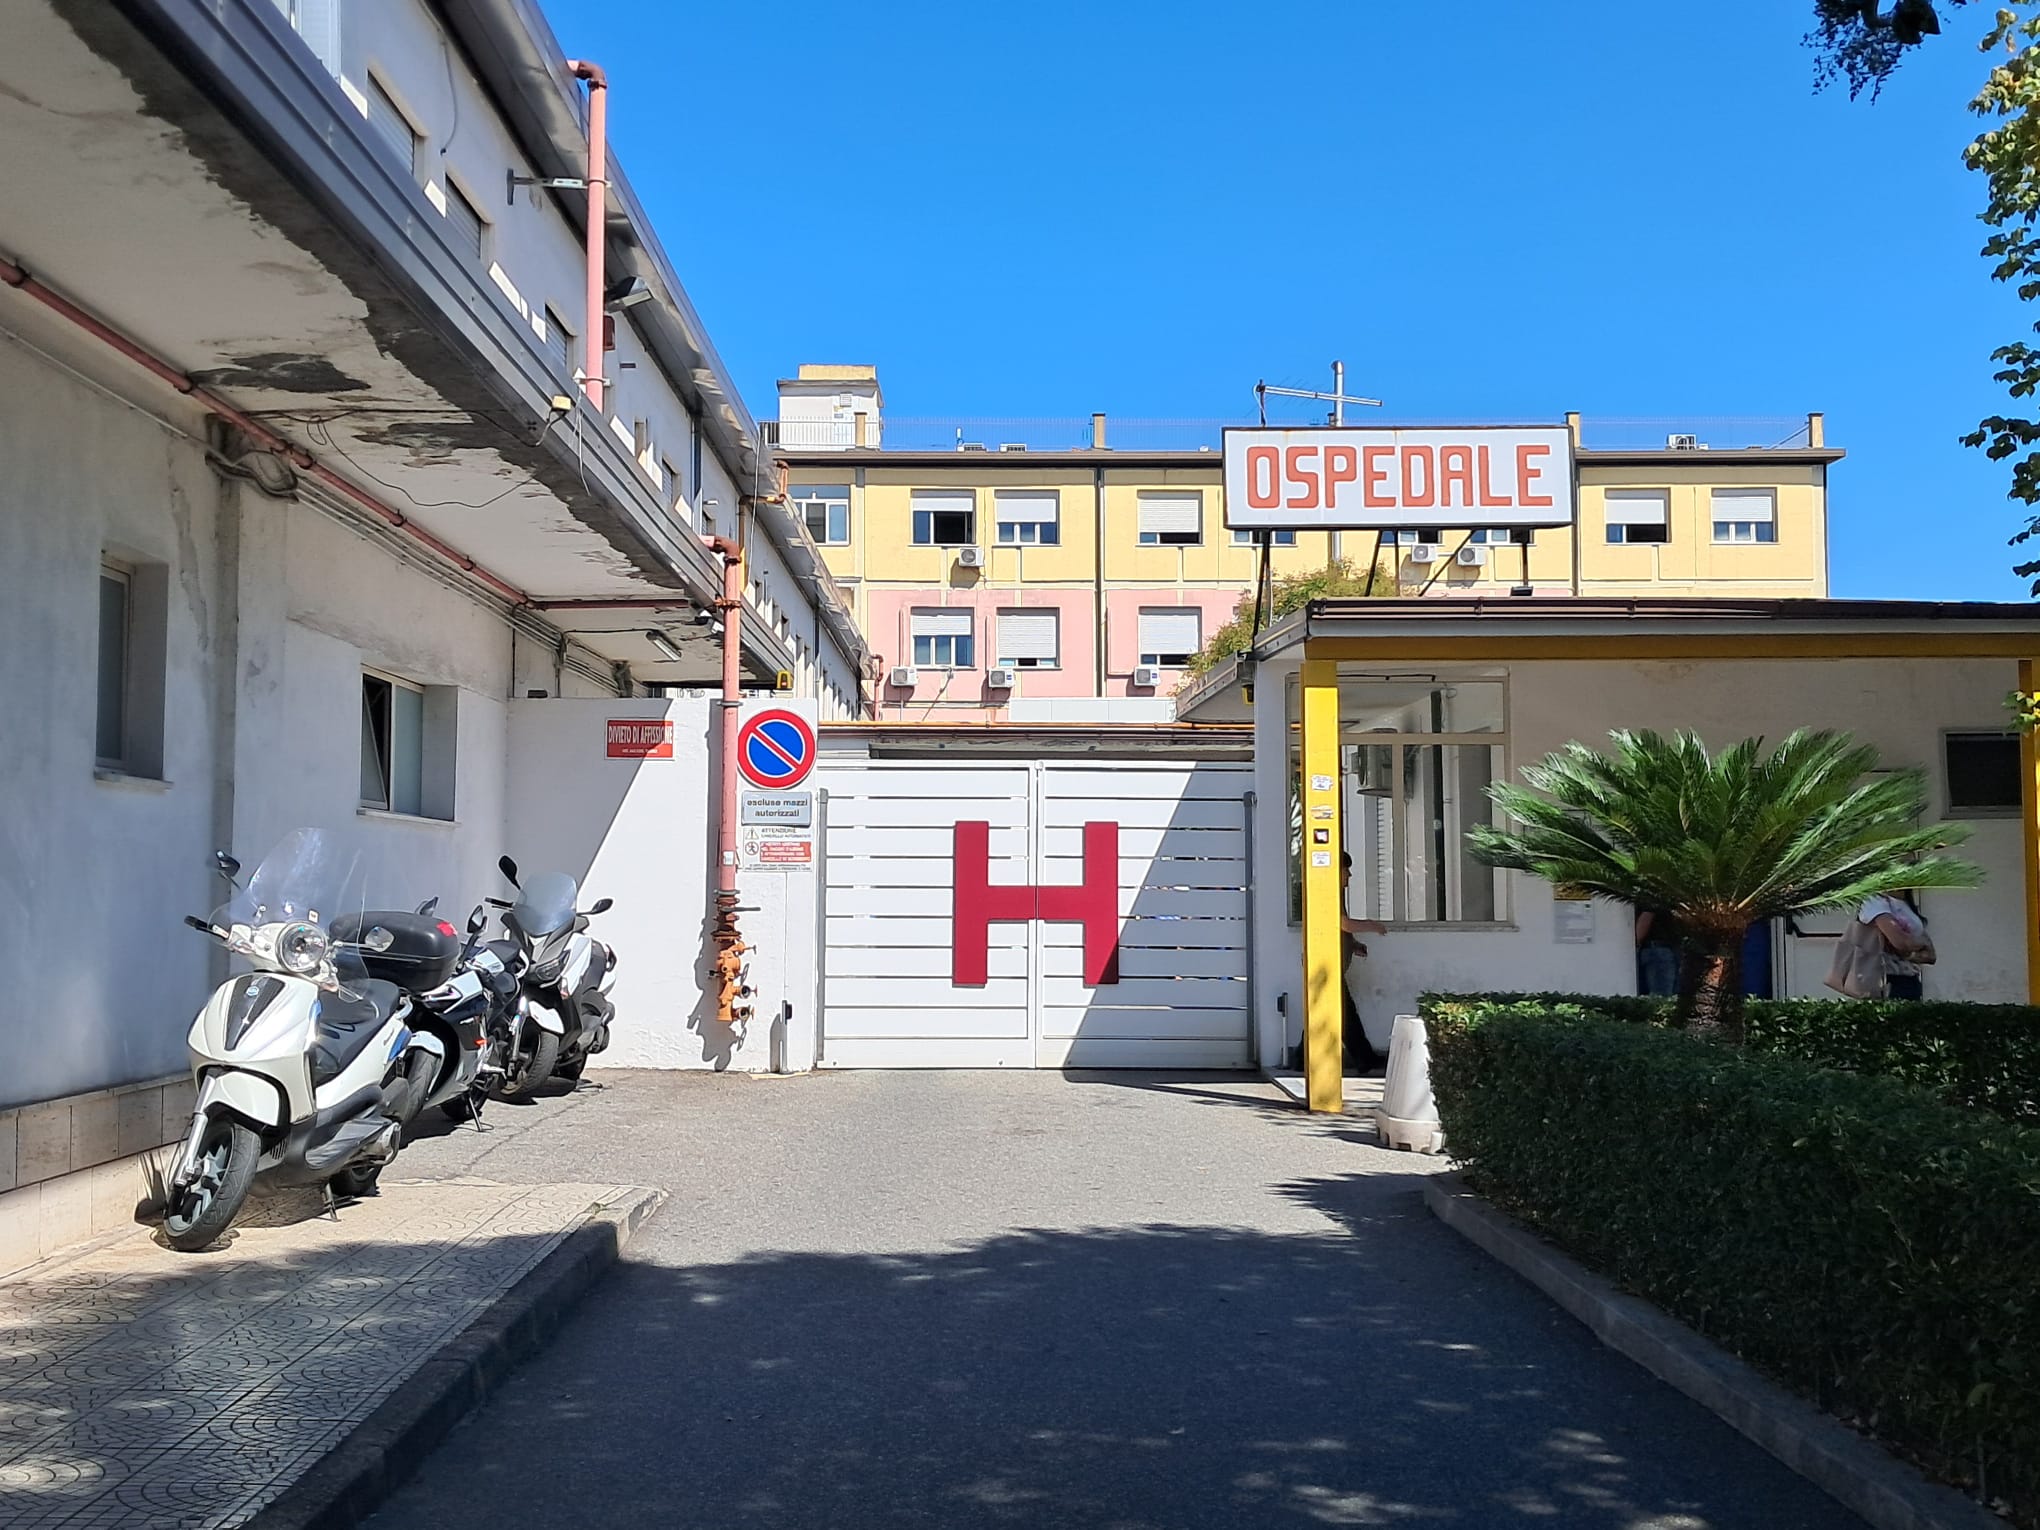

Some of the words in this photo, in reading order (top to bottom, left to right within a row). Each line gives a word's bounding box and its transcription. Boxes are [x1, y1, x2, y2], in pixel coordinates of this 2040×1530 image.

[1246, 445, 1553, 508] OSPEDALE
[608, 725, 631, 744] DIVIETO
[632, 725, 639, 744] DI
[640, 725, 673, 744] AFFISSIONE
[783, 798, 808, 806] mezzi
[755, 809, 800, 817] autorizzati
[952, 820, 1119, 985] H
